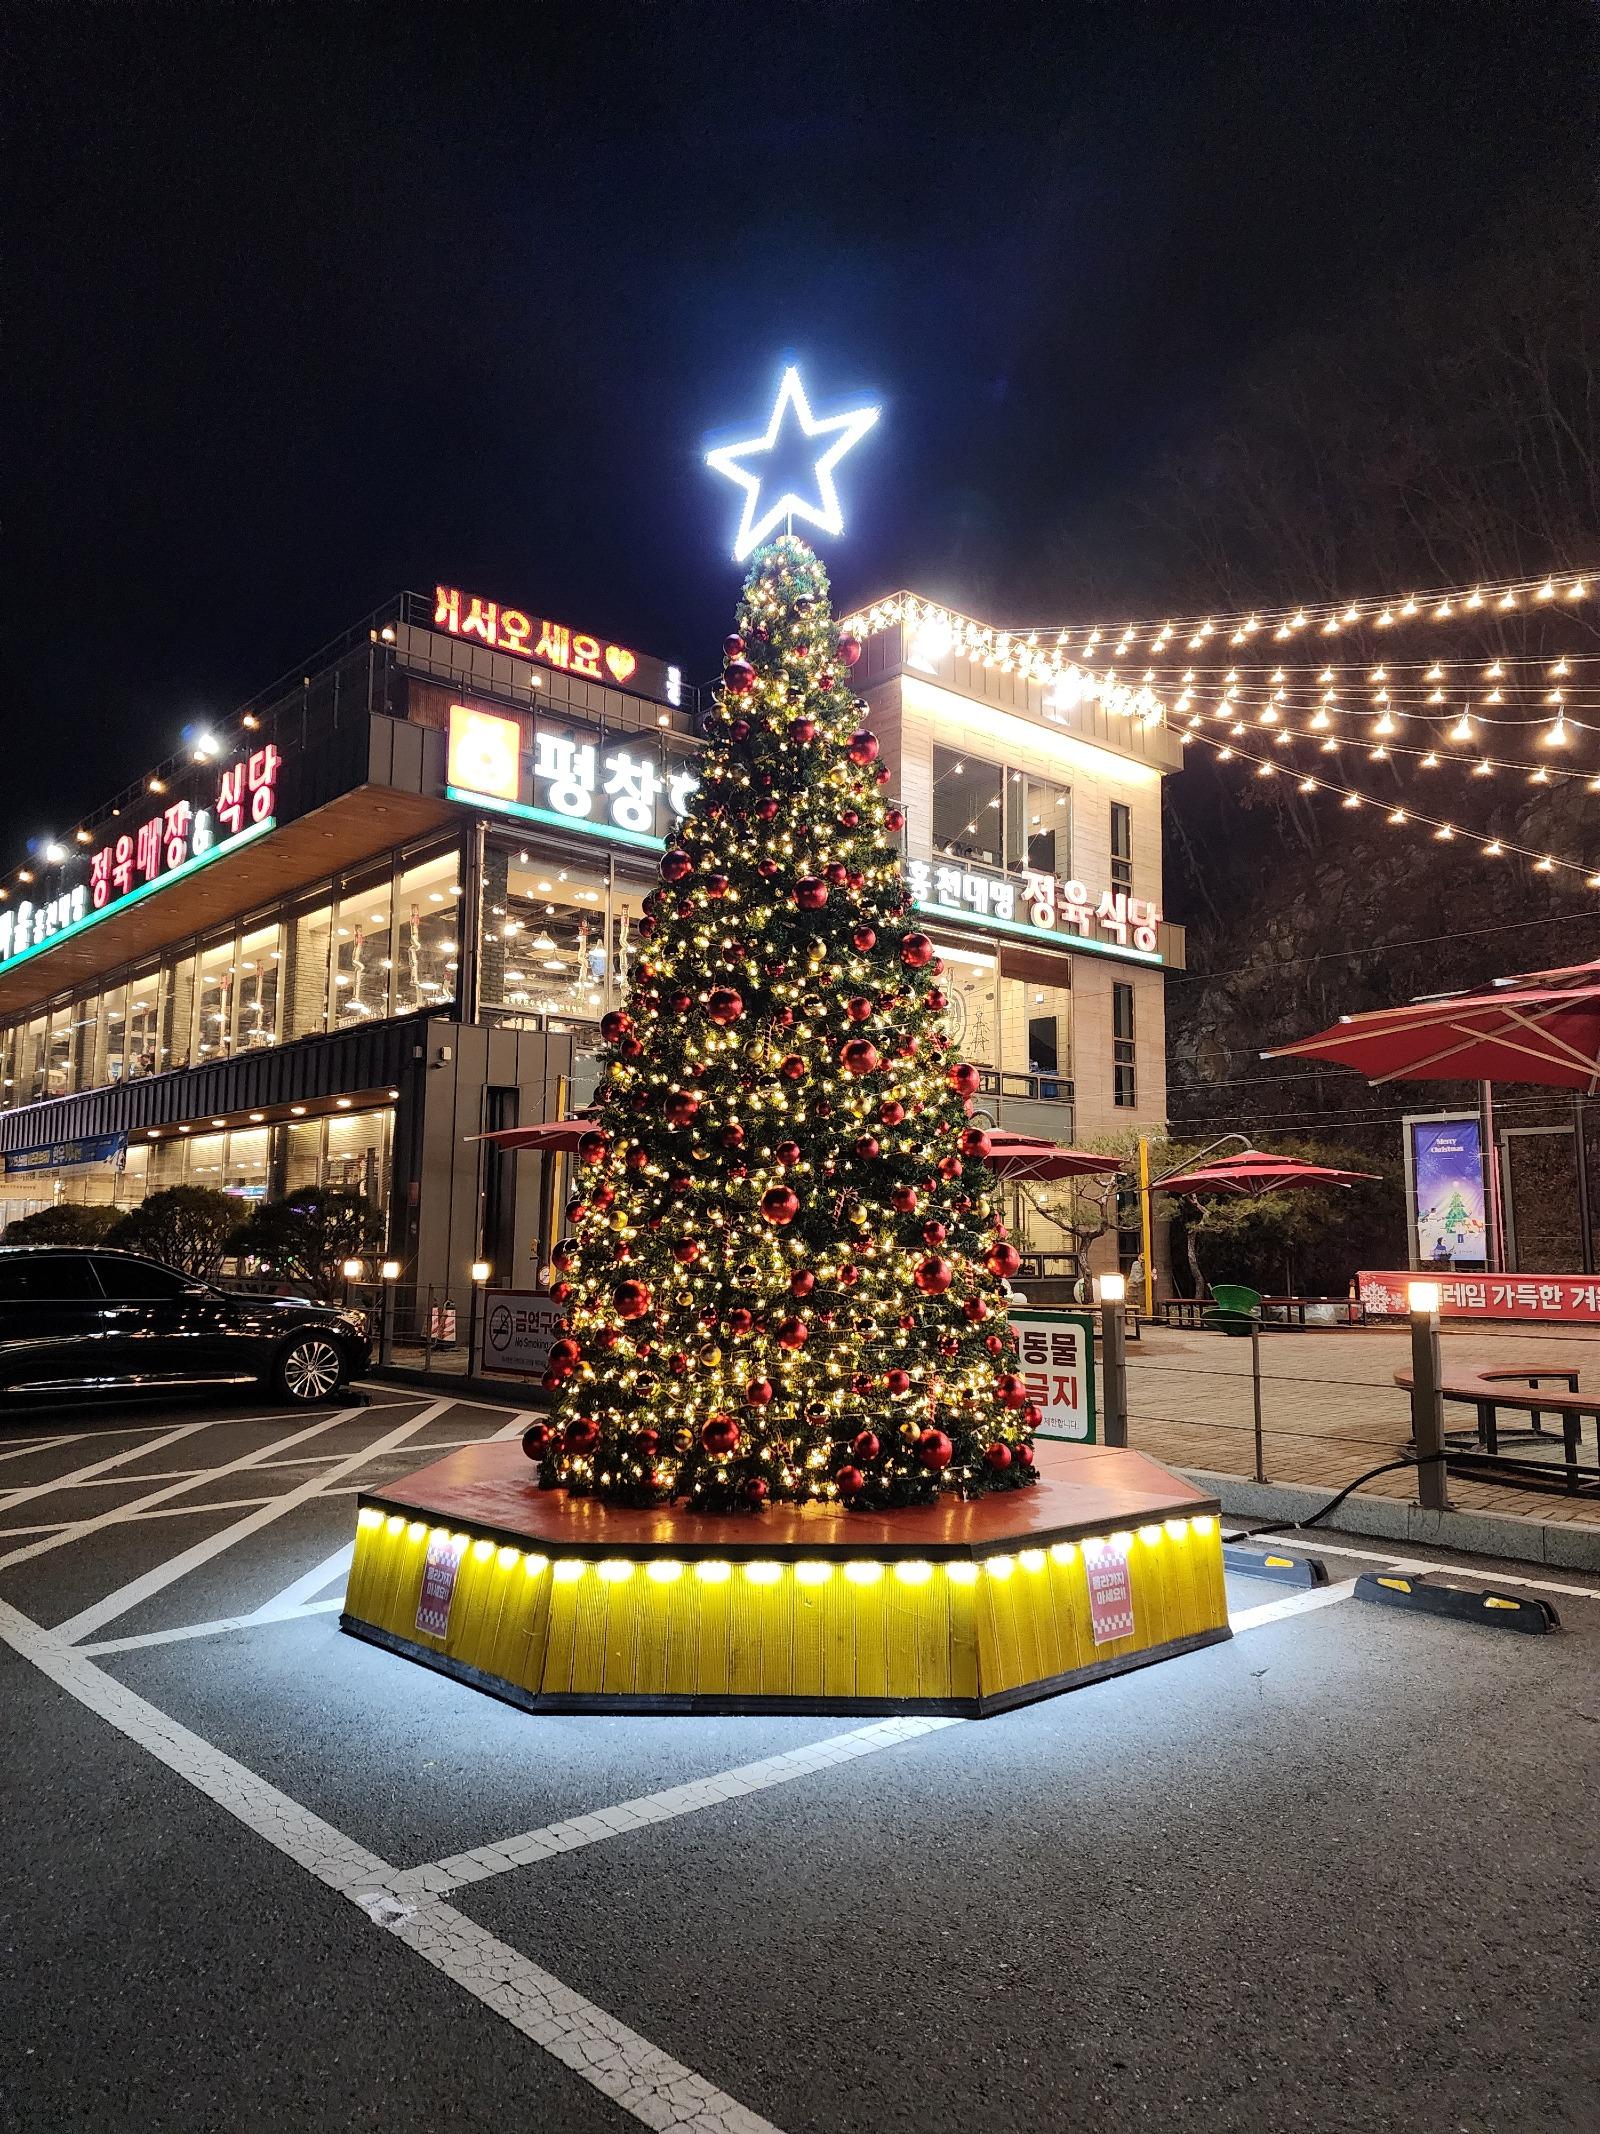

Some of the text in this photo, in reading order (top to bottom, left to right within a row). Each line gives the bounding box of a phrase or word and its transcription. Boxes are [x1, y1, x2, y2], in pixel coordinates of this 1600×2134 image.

[1020, 870, 1163, 951] 정육식당
[1491, 1284, 1563, 1310] 가득한
[1570, 1285, 1600, 1312] 겨
[1025, 1372, 1078, 1410] 금지
